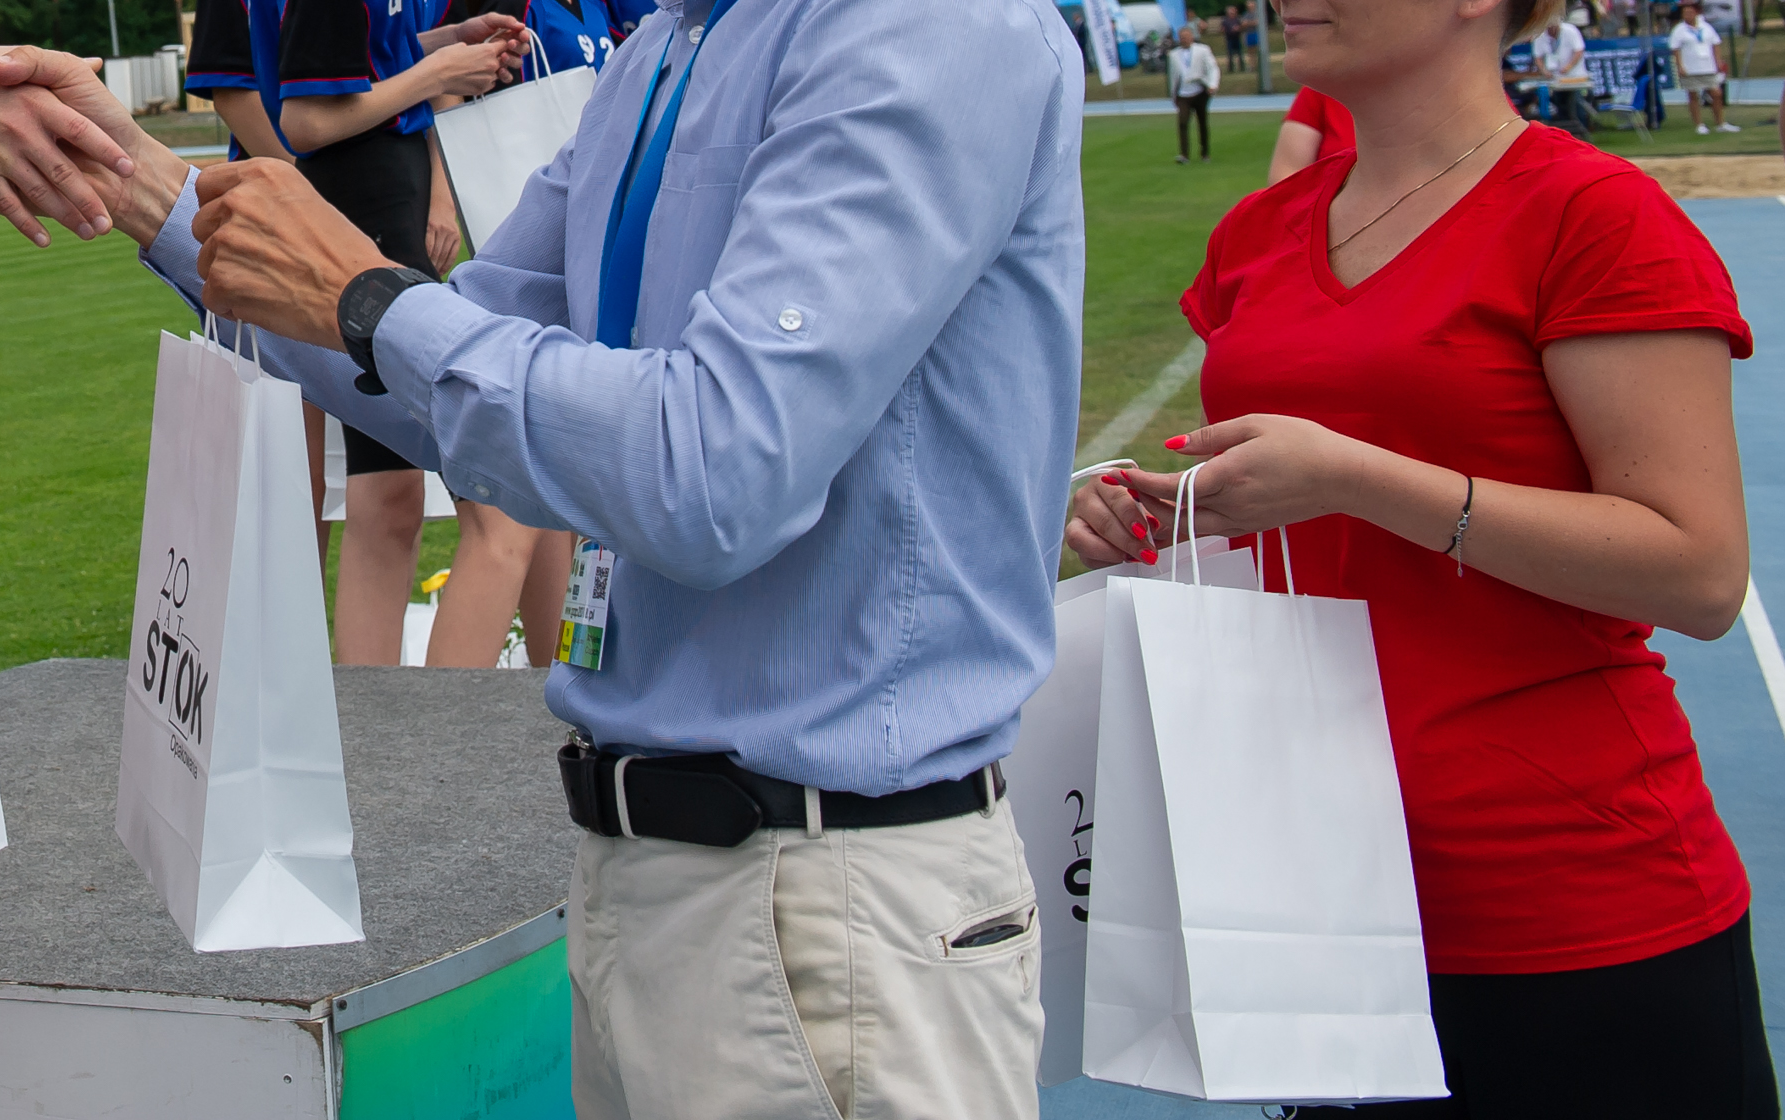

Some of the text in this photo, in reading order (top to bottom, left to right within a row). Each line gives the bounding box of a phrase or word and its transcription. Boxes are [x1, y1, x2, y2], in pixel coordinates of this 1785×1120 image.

[160, 546, 190, 609] 20
[156, 599, 185, 637] LAT
[143, 619, 209, 746] STOK
[170, 733, 199, 780] Opakowania
